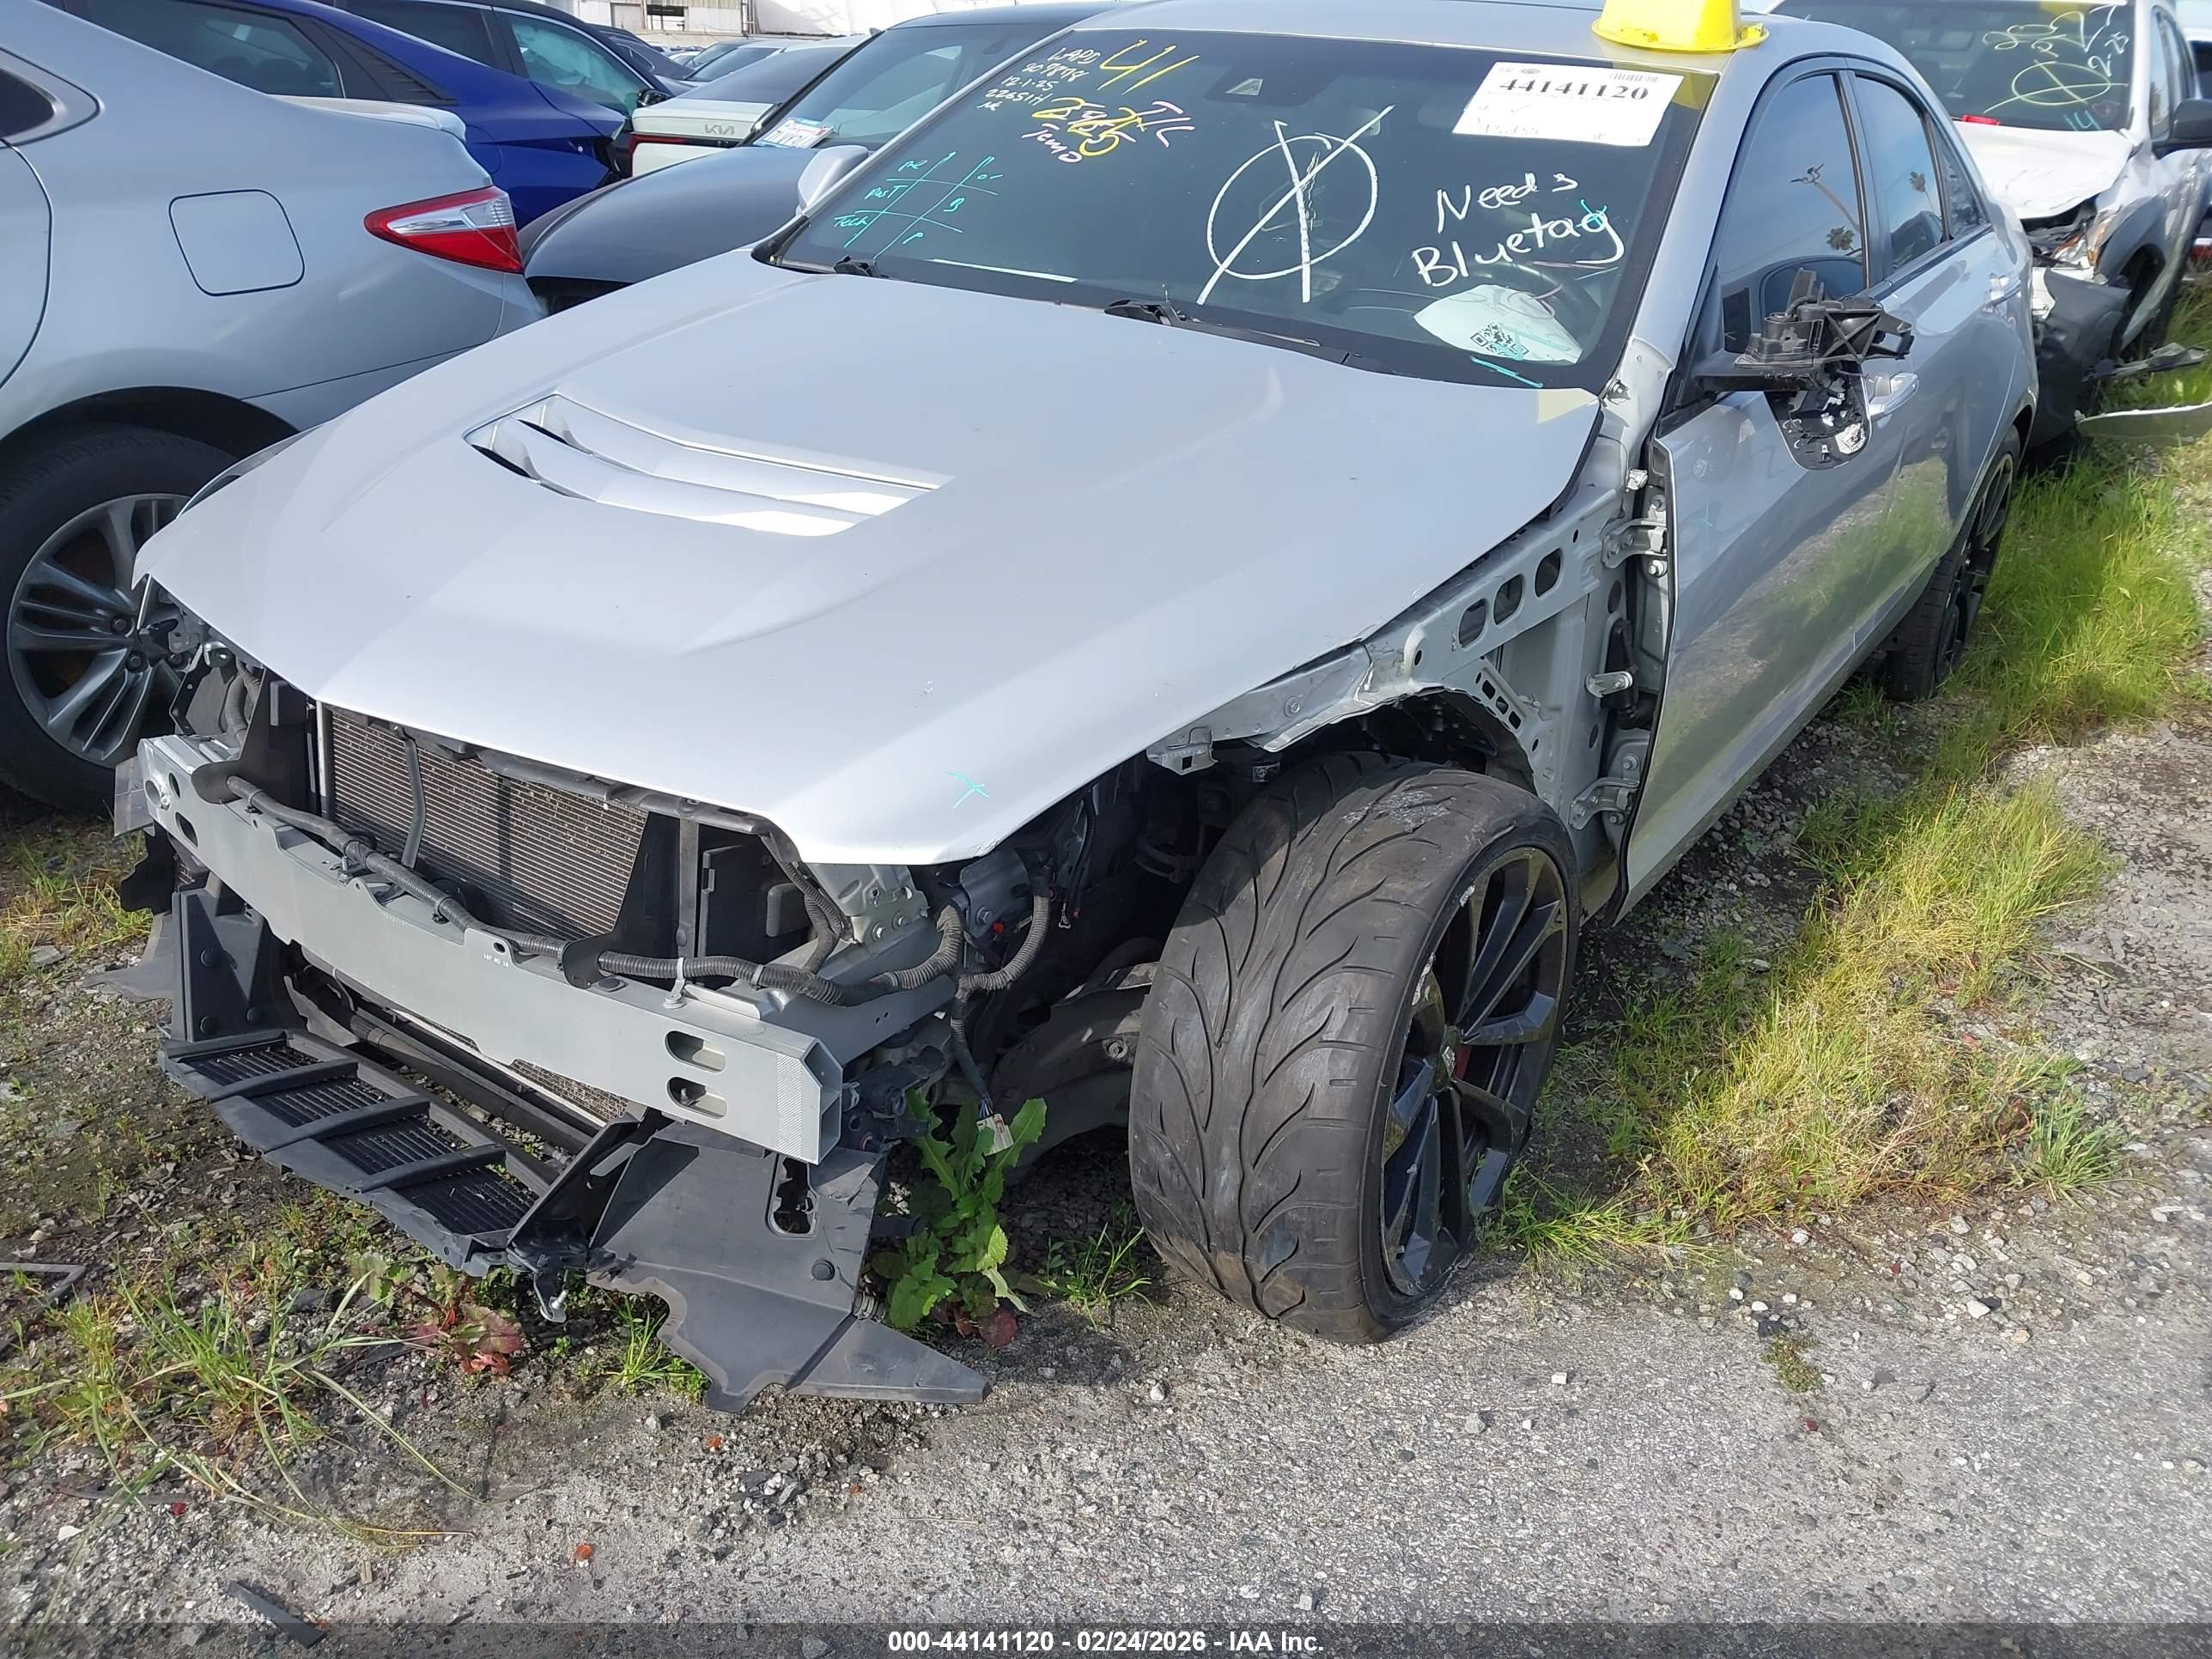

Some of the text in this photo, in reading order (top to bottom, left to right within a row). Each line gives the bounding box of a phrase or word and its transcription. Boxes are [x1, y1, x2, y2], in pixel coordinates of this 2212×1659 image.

[1047, 46, 1101, 64] LAPD
[1498, 78, 1649, 100] 44141120
[1437, 172, 1579, 234] Needs
